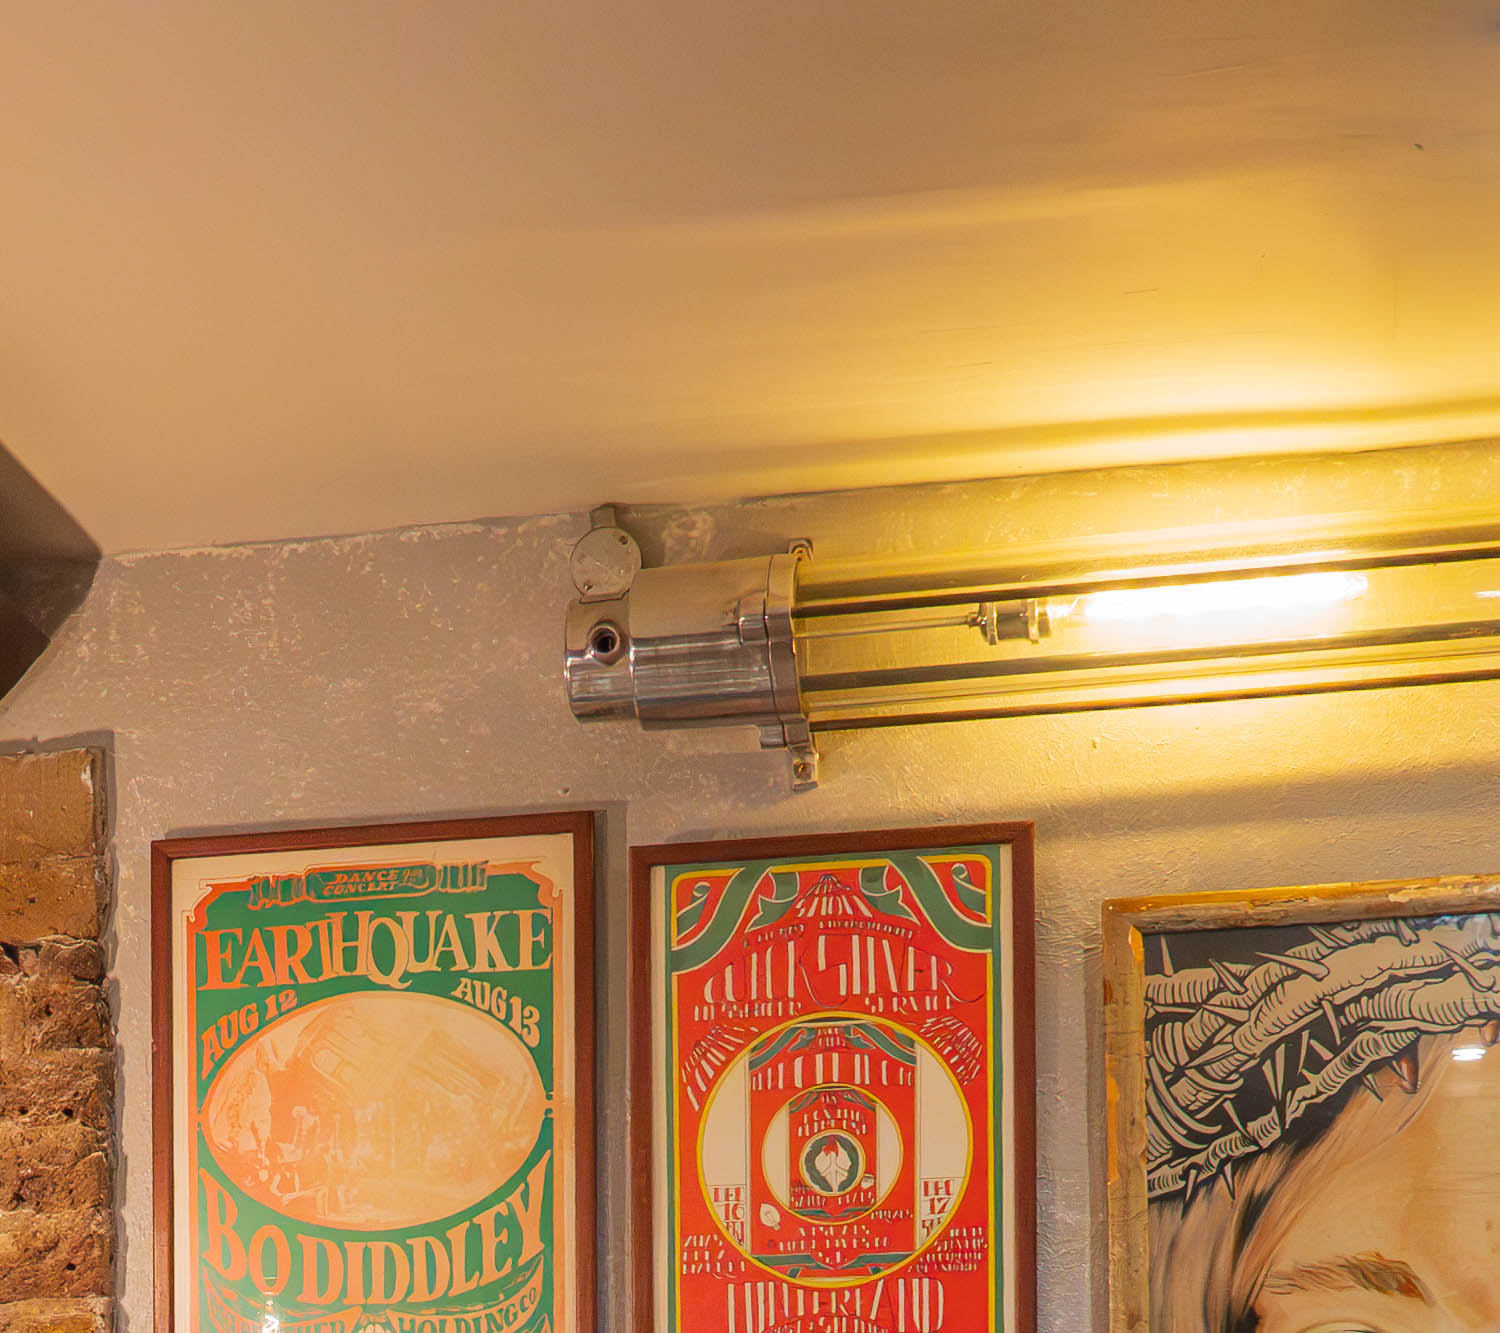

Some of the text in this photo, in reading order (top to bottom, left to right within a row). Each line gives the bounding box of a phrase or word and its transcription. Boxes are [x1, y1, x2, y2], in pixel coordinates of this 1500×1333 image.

[198, 908, 554, 991] EARTHQUAKE
[200, 989, 298, 1075] AUG 12
[452, 977, 542, 1049] AUG 13
[199, 1149, 552, 1305] BO DIDDLEY
